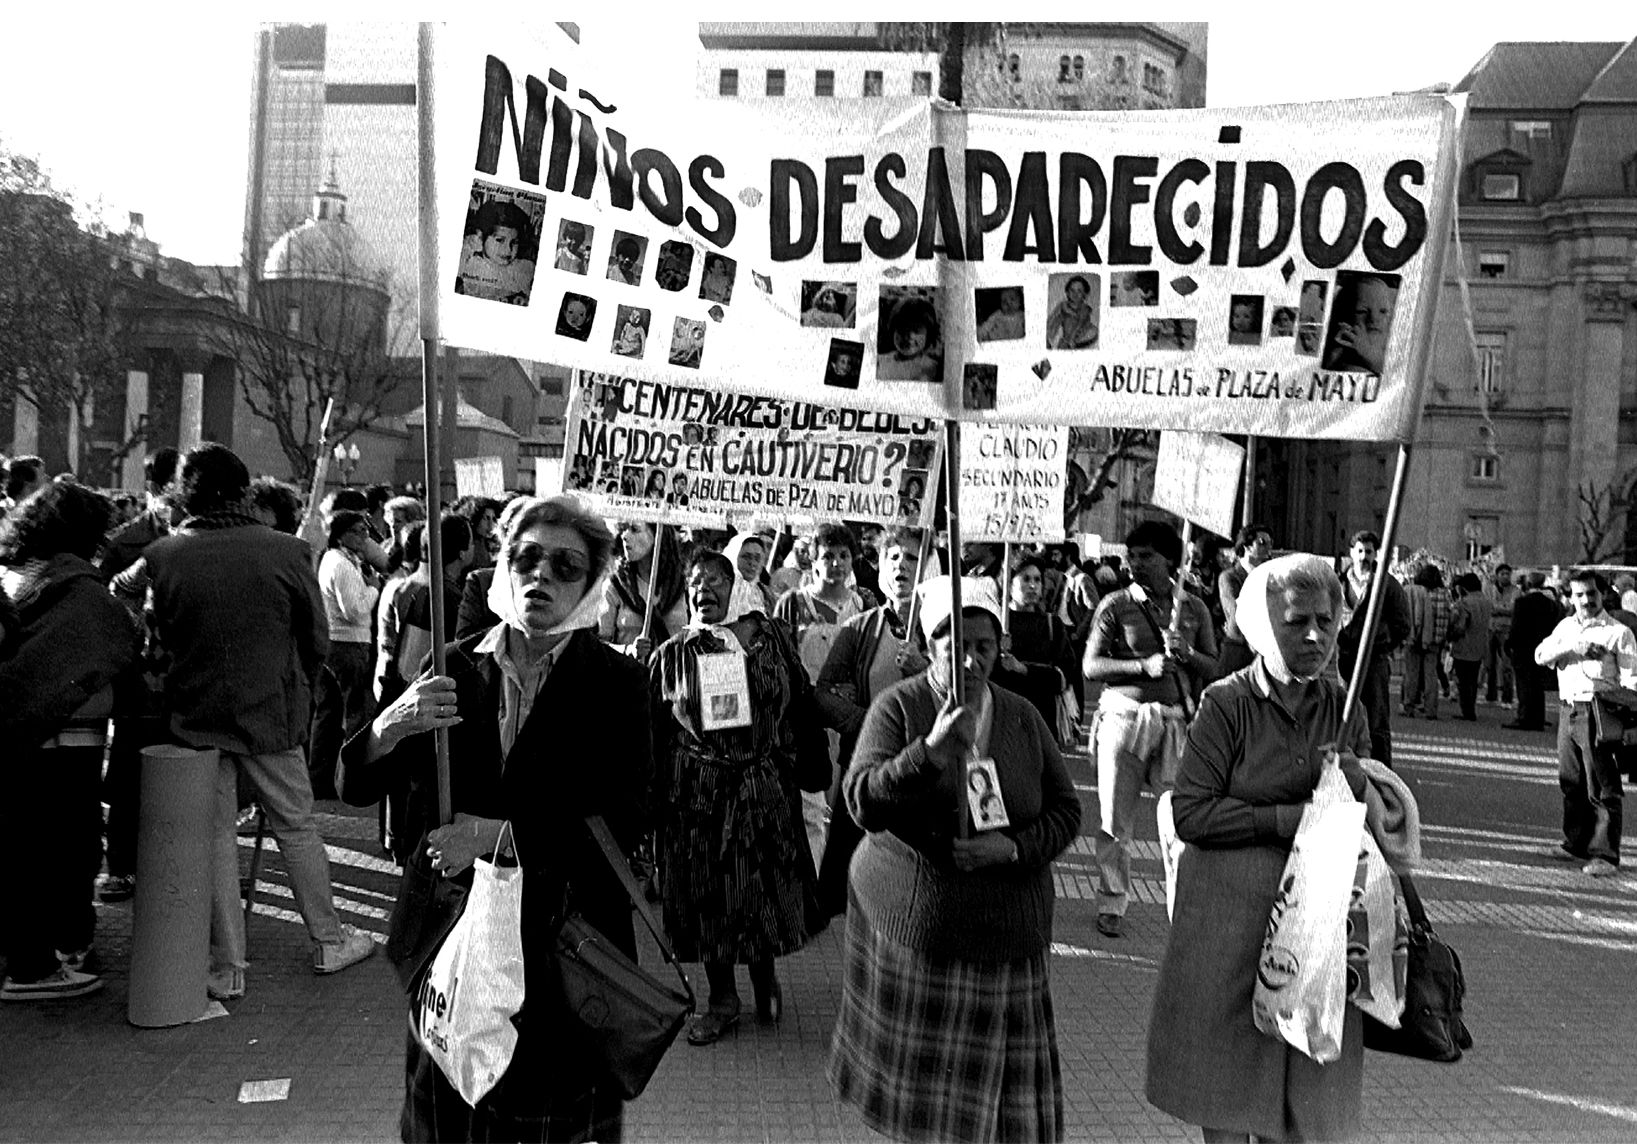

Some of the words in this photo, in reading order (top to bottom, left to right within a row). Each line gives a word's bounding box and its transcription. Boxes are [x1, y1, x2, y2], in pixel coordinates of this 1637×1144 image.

[770, 126, 1429, 270] DESAPARECIDOS
[1091, 364, 1193, 397] ABUELAS
[1215, 367, 1280, 399] PLAZA
[1285, 379, 1304, 399] de
[1308, 371, 1381, 403] MAYO
[577, 418, 683, 469] NACIDOS
[686, 443, 714, 473] EN
[980, 434, 1057, 461] CLAUDIO
[690, 476, 763, 505] ABUELAS
[766, 487, 785, 507] DE
[788, 483, 818, 511] PZA
[828, 493, 845, 512] DE
[849, 491, 895, 518] MAYO
[962, 468, 1059, 489] SECUNDARIO
